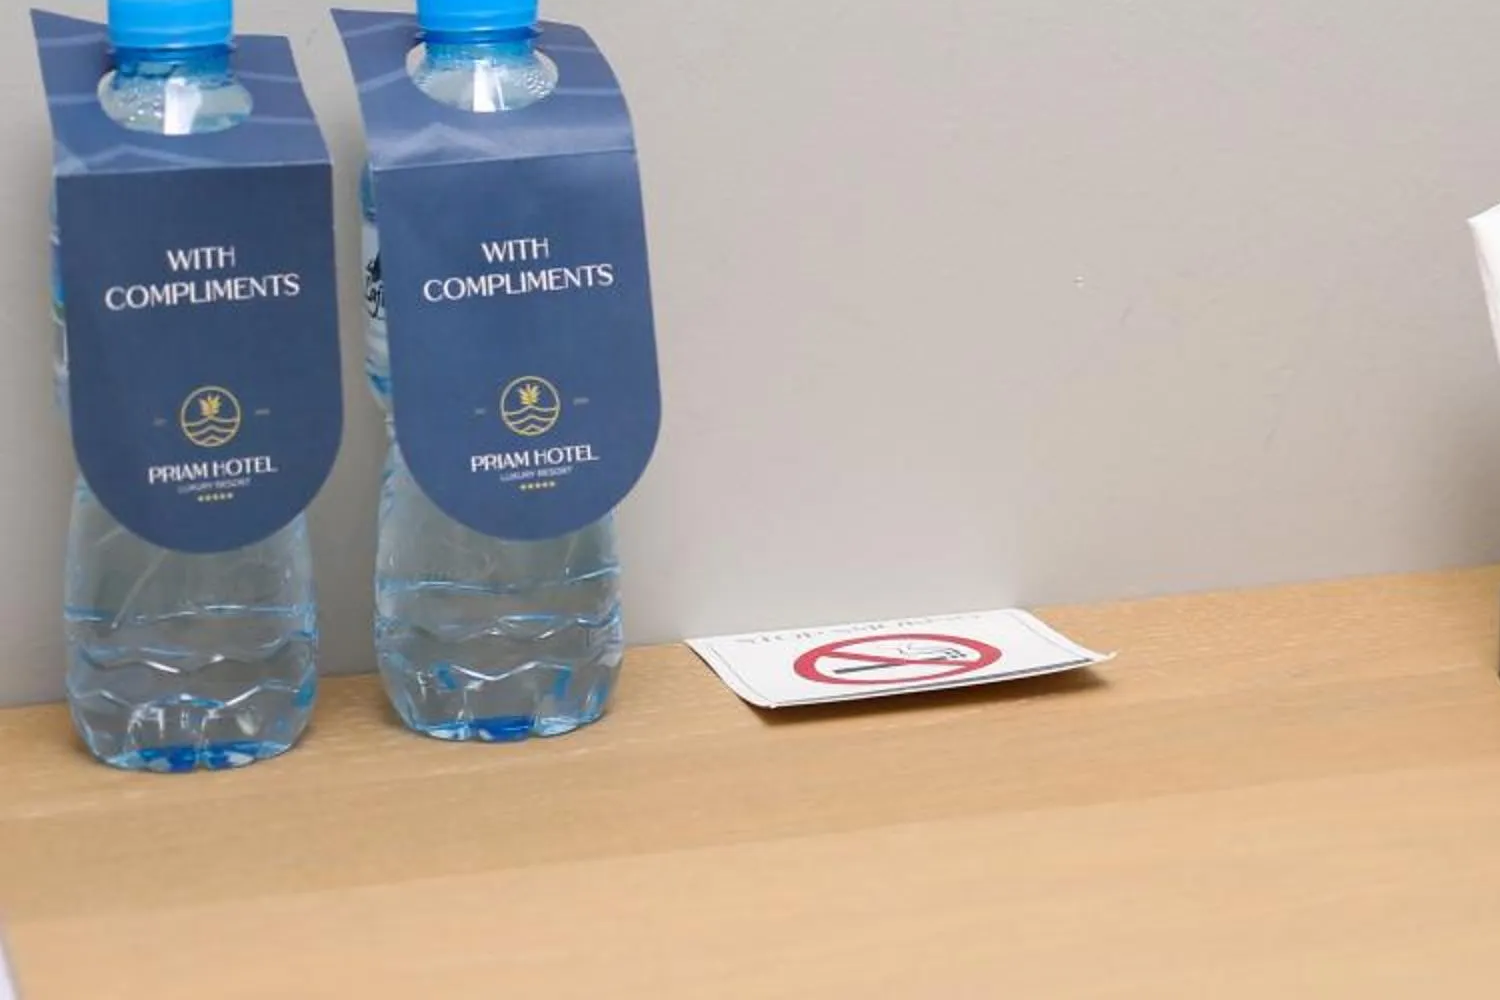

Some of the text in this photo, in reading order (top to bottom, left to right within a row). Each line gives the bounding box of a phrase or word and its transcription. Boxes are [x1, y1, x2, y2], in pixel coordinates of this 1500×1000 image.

[166, 244, 236, 272] WITH
[481, 238, 550, 264] WITH
[104, 272, 301, 311] COMPLIMENTS
[423, 263, 615, 302] COMPLIMENTS
[148, 455, 279, 485] PRIAM HOTEL
[470, 444, 600, 473] PRIAM HOTEL
